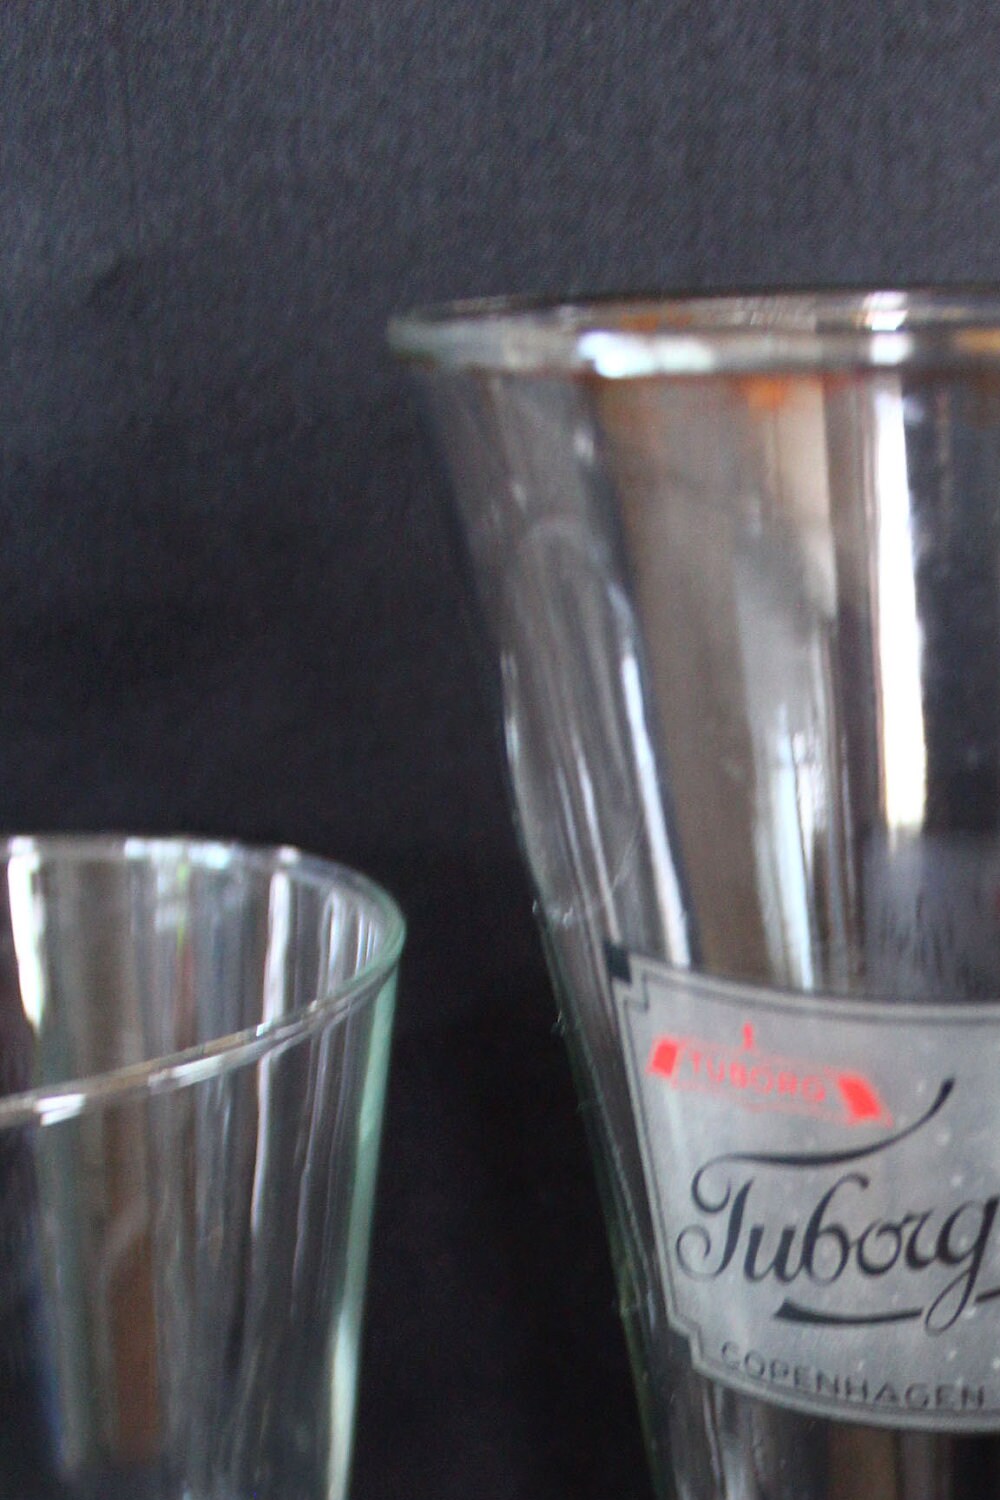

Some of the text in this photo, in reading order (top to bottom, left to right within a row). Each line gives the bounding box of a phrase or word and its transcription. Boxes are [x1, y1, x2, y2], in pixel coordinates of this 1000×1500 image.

[689, 1050, 826, 1104] TUBORG
[675, 1078, 1000, 1335] Tuborg
[721, 1340, 985, 1409] COPENHAGEN
